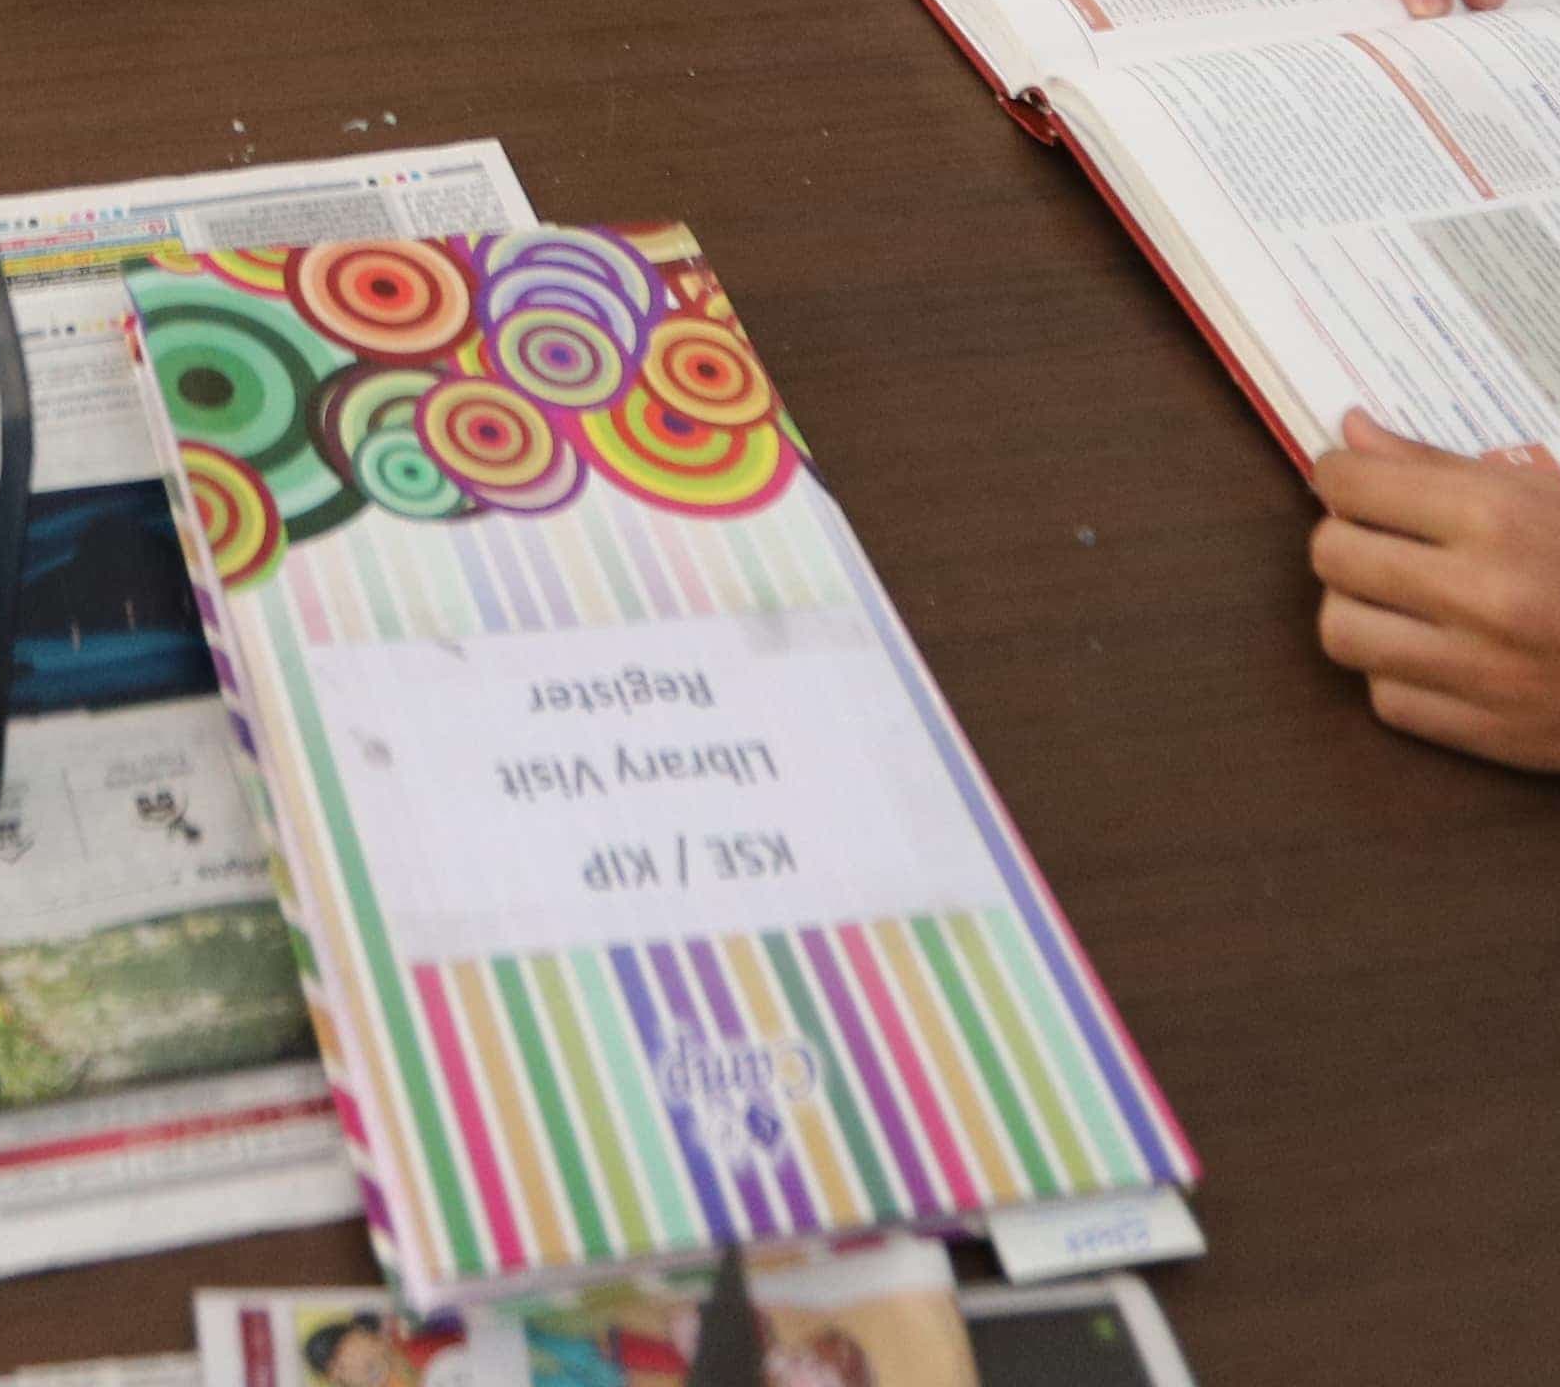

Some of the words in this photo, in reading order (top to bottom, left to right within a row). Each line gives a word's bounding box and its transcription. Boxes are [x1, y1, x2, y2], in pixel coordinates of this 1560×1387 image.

[529, 664, 716, 715] Register
[494, 752, 608, 803] Visit
[612, 738, 780, 787] Library
[582, 842, 660, 891] KIP
[673, 831, 689, 889] /
[705, 830, 798, 880] KSE
